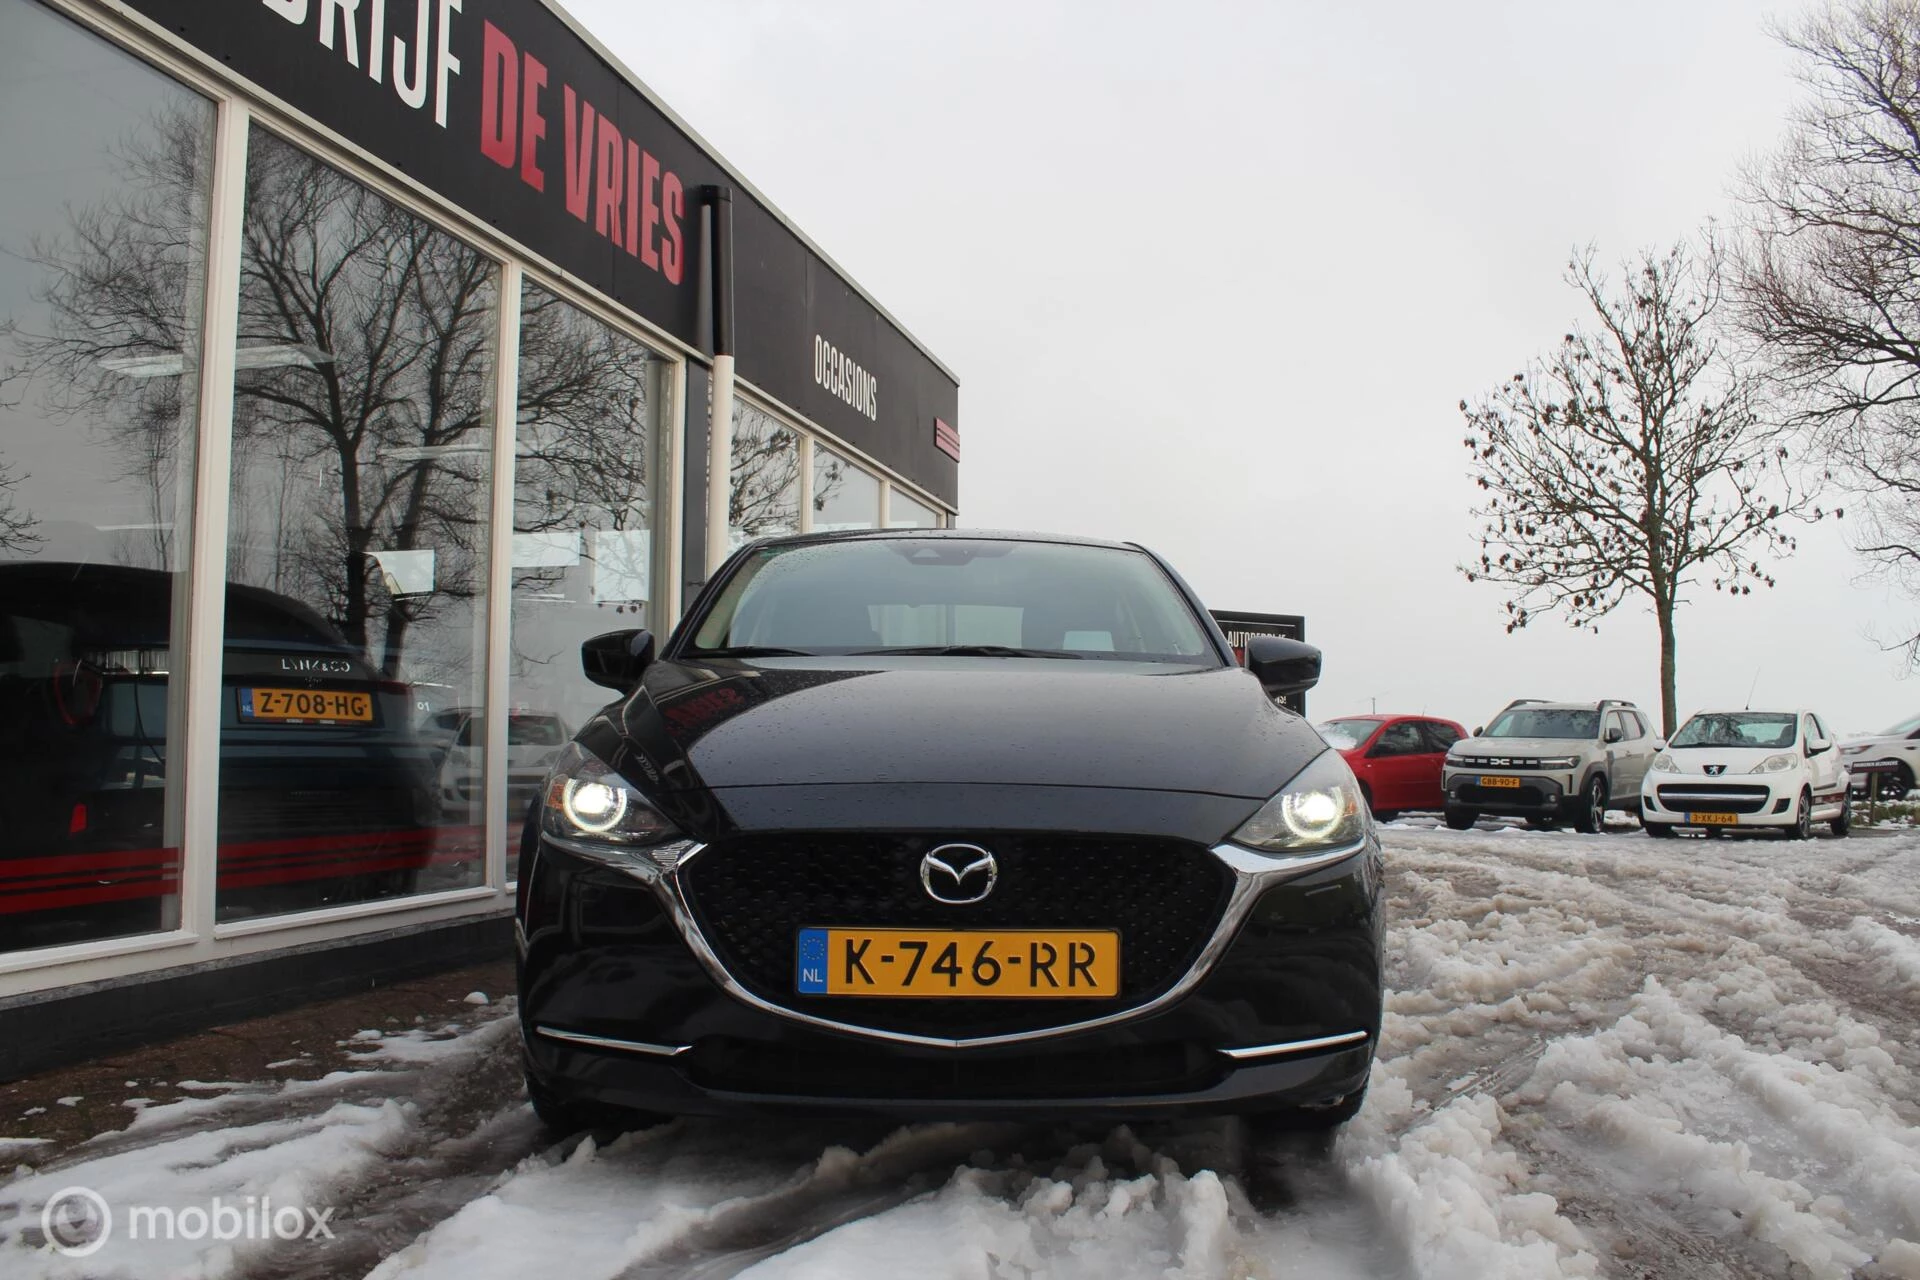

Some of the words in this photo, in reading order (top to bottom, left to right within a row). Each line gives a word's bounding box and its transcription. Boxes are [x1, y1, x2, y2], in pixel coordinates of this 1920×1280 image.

[480, 18, 548, 193] DE
[564, 83, 684, 286] VRIES
[815, 334, 877, 421] OCCASIONS
[260, 692, 364, 716] Z-708-HG
[803, 968, 823, 983] NL
[845, 938, 1098, 987] K-746-RR
